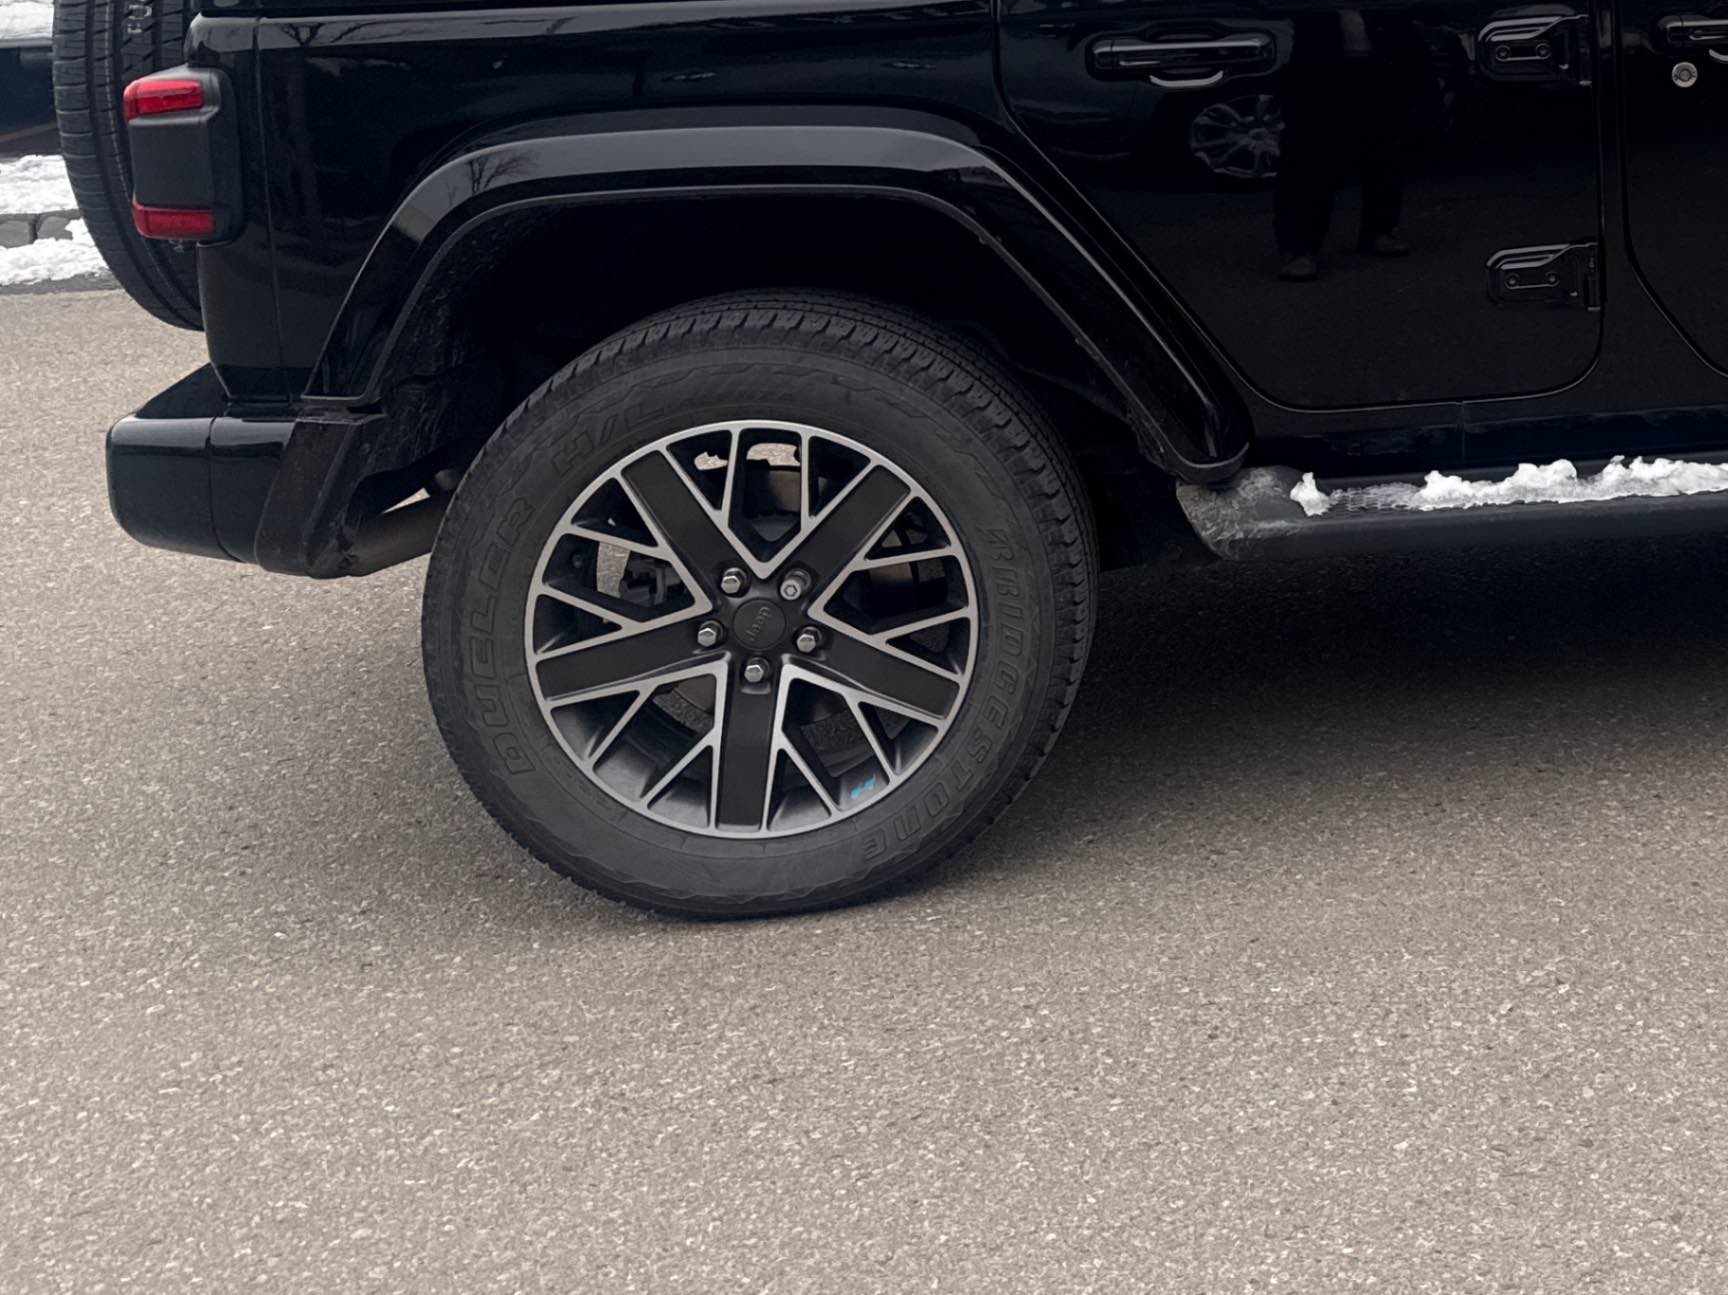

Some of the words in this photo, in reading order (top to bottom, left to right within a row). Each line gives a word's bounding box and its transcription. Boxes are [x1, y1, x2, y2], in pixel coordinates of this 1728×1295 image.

[470, 496, 537, 777] DUELER
[744, 605, 772, 642] Jeep
[861, 525, 1027, 862] BRIDGESTONE
